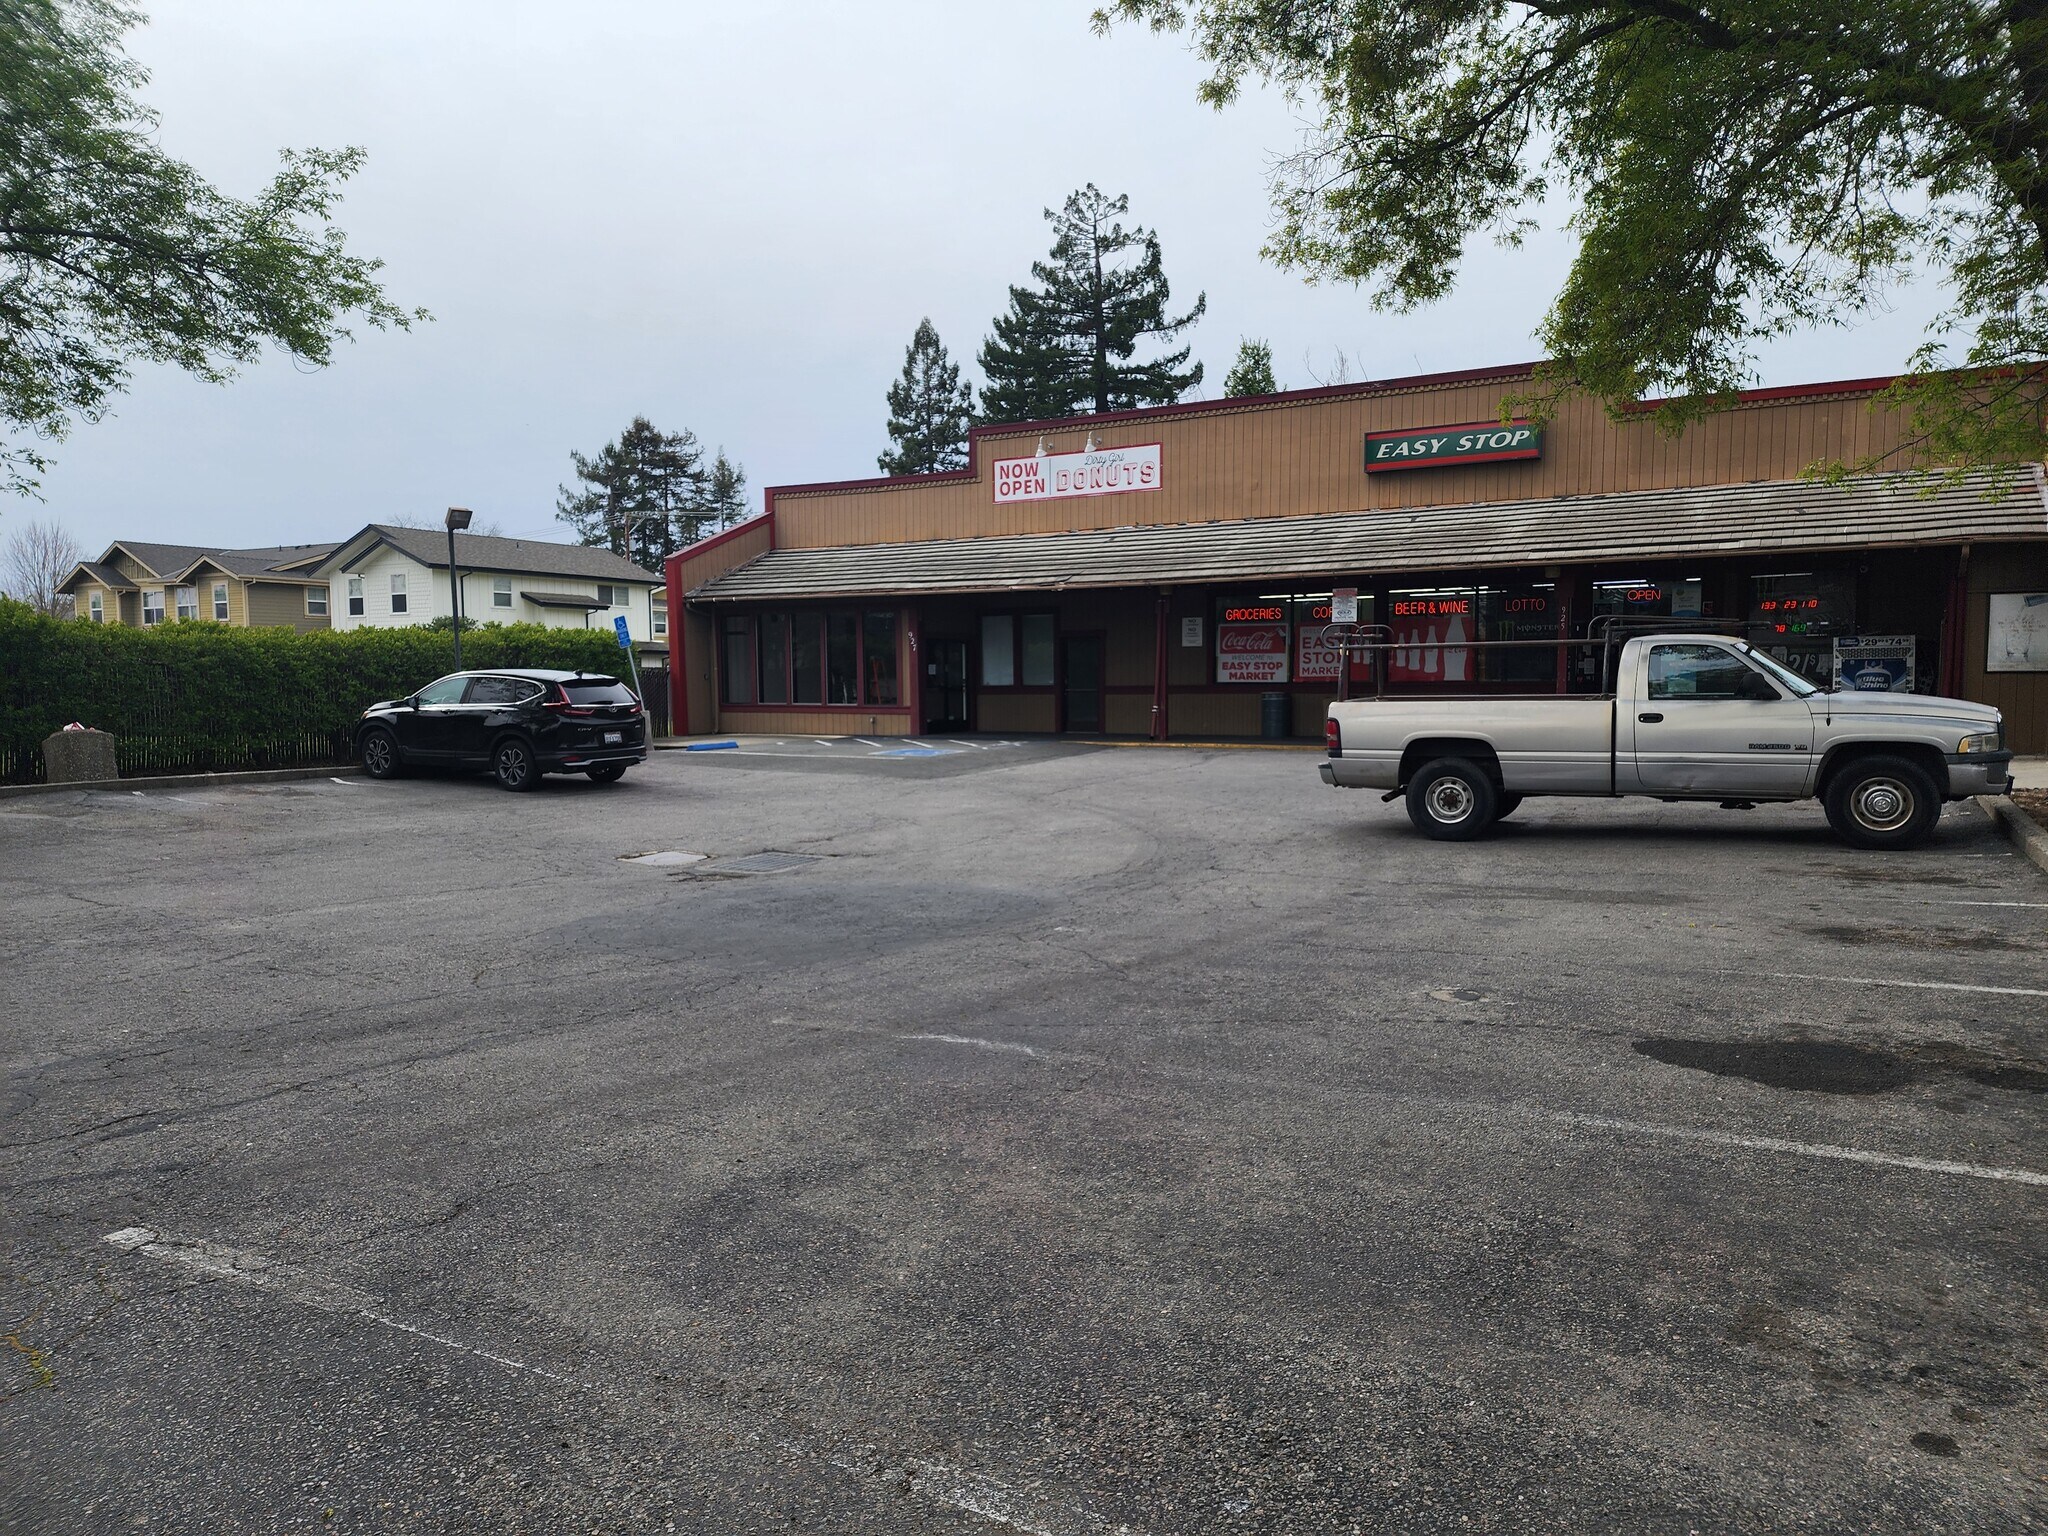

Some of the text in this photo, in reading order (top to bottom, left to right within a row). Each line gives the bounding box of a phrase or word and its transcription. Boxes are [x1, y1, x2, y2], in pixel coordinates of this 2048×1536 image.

[1376, 430, 1531, 458] EASY STOP
[1085, 453, 1126, 467] Dirty Girl
[1000, 462, 1039, 480] NOW
[1056, 461, 1155, 492] DONUTS
[1000, 478, 1045, 496] OPEN
[1627, 589, 1661, 601] OPEN
[1395, 600, 1469, 615] BEER & WINE
[1505, 599, 1546, 612] LOTTO
[1761, 601, 1777, 610] 133
[1784, 600, 1797, 609] 23
[1225, 607, 1282, 620] GROCERIES
[1222, 661, 1283, 670] EASY STOP
[1229, 672, 1275, 680] MARKET
